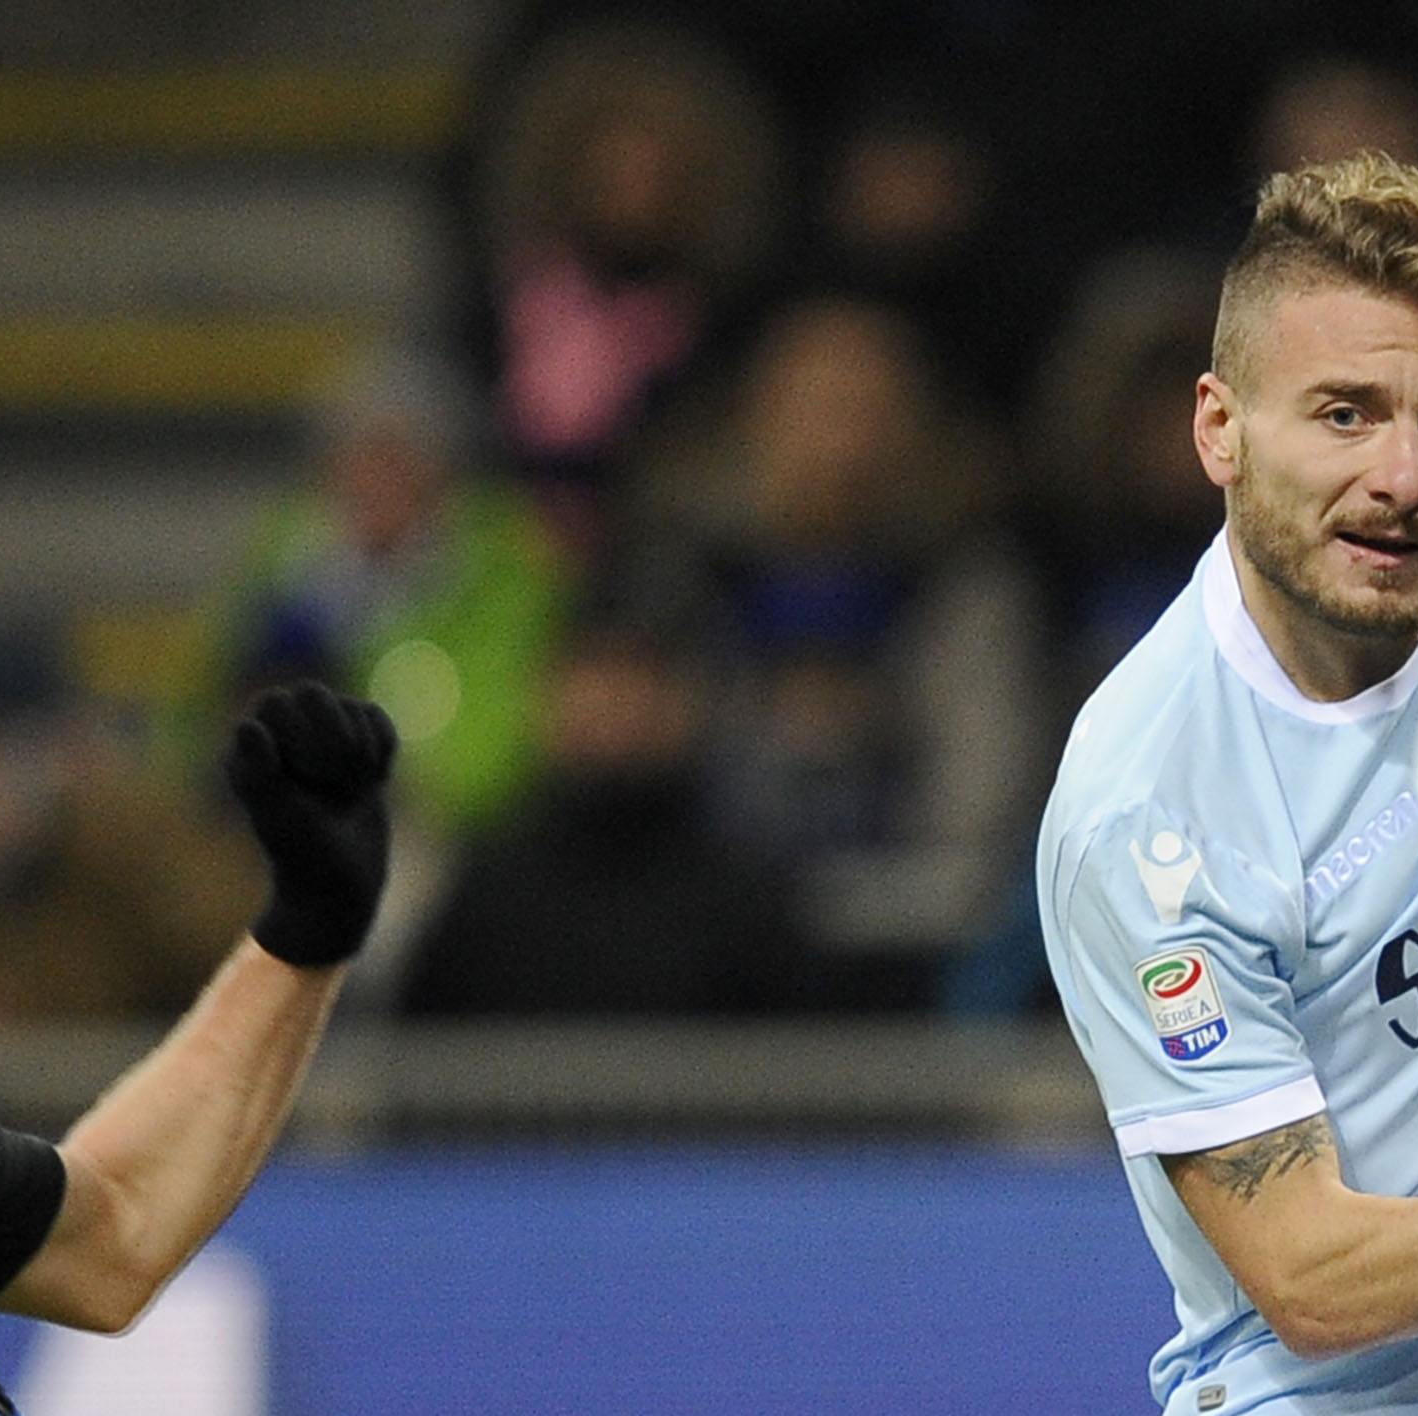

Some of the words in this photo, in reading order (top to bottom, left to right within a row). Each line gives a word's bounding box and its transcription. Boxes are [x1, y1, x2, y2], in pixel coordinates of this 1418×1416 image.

[1156, 1006, 1197, 1028] SERIE
[1200, 1000, 1212, 1017] A
[1182, 1024, 1220, 1052] TIM
